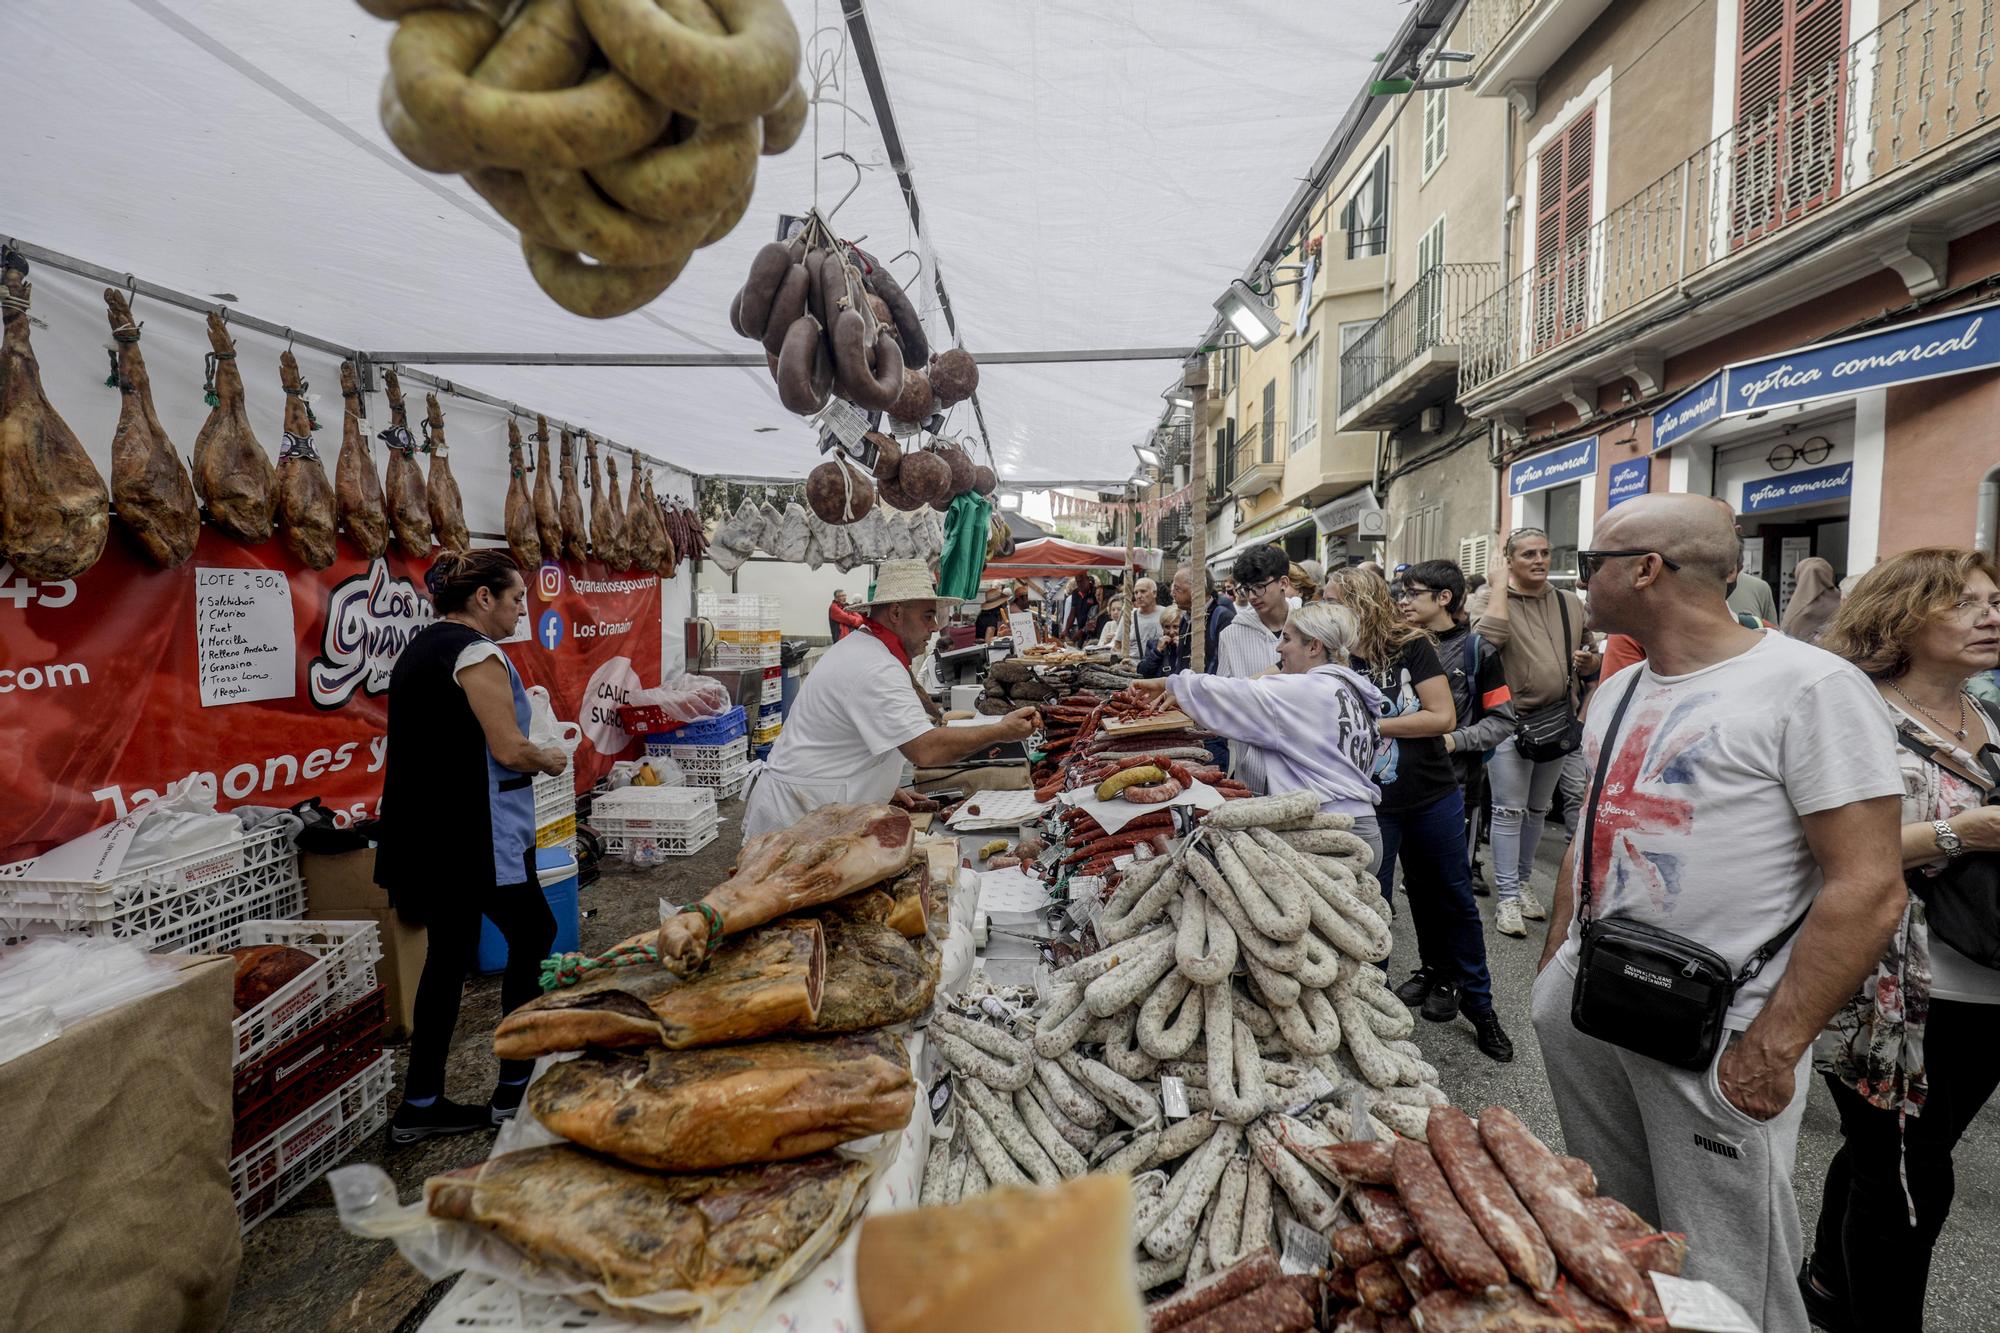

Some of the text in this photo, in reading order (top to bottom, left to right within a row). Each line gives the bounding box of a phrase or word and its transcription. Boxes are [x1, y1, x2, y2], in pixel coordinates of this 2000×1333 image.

[1740, 317, 1983, 407] optica comarcal
[1656, 380, 1718, 446] optica comarcal
[1516, 445, 1590, 491] optica comarcal
[1614, 468, 1639, 487] optica
[1610, 475, 1646, 495] comarcal
[1750, 467, 1851, 508] optica comarcal
[1364, 511, 1383, 531] Q
[201, 573, 234, 586] LOTE
[210, 622, 232, 633] Fuet
[573, 621, 596, 637] Los
[1600, 801, 1636, 817] Jeans
[1694, 1134, 1739, 1160] PUMA
